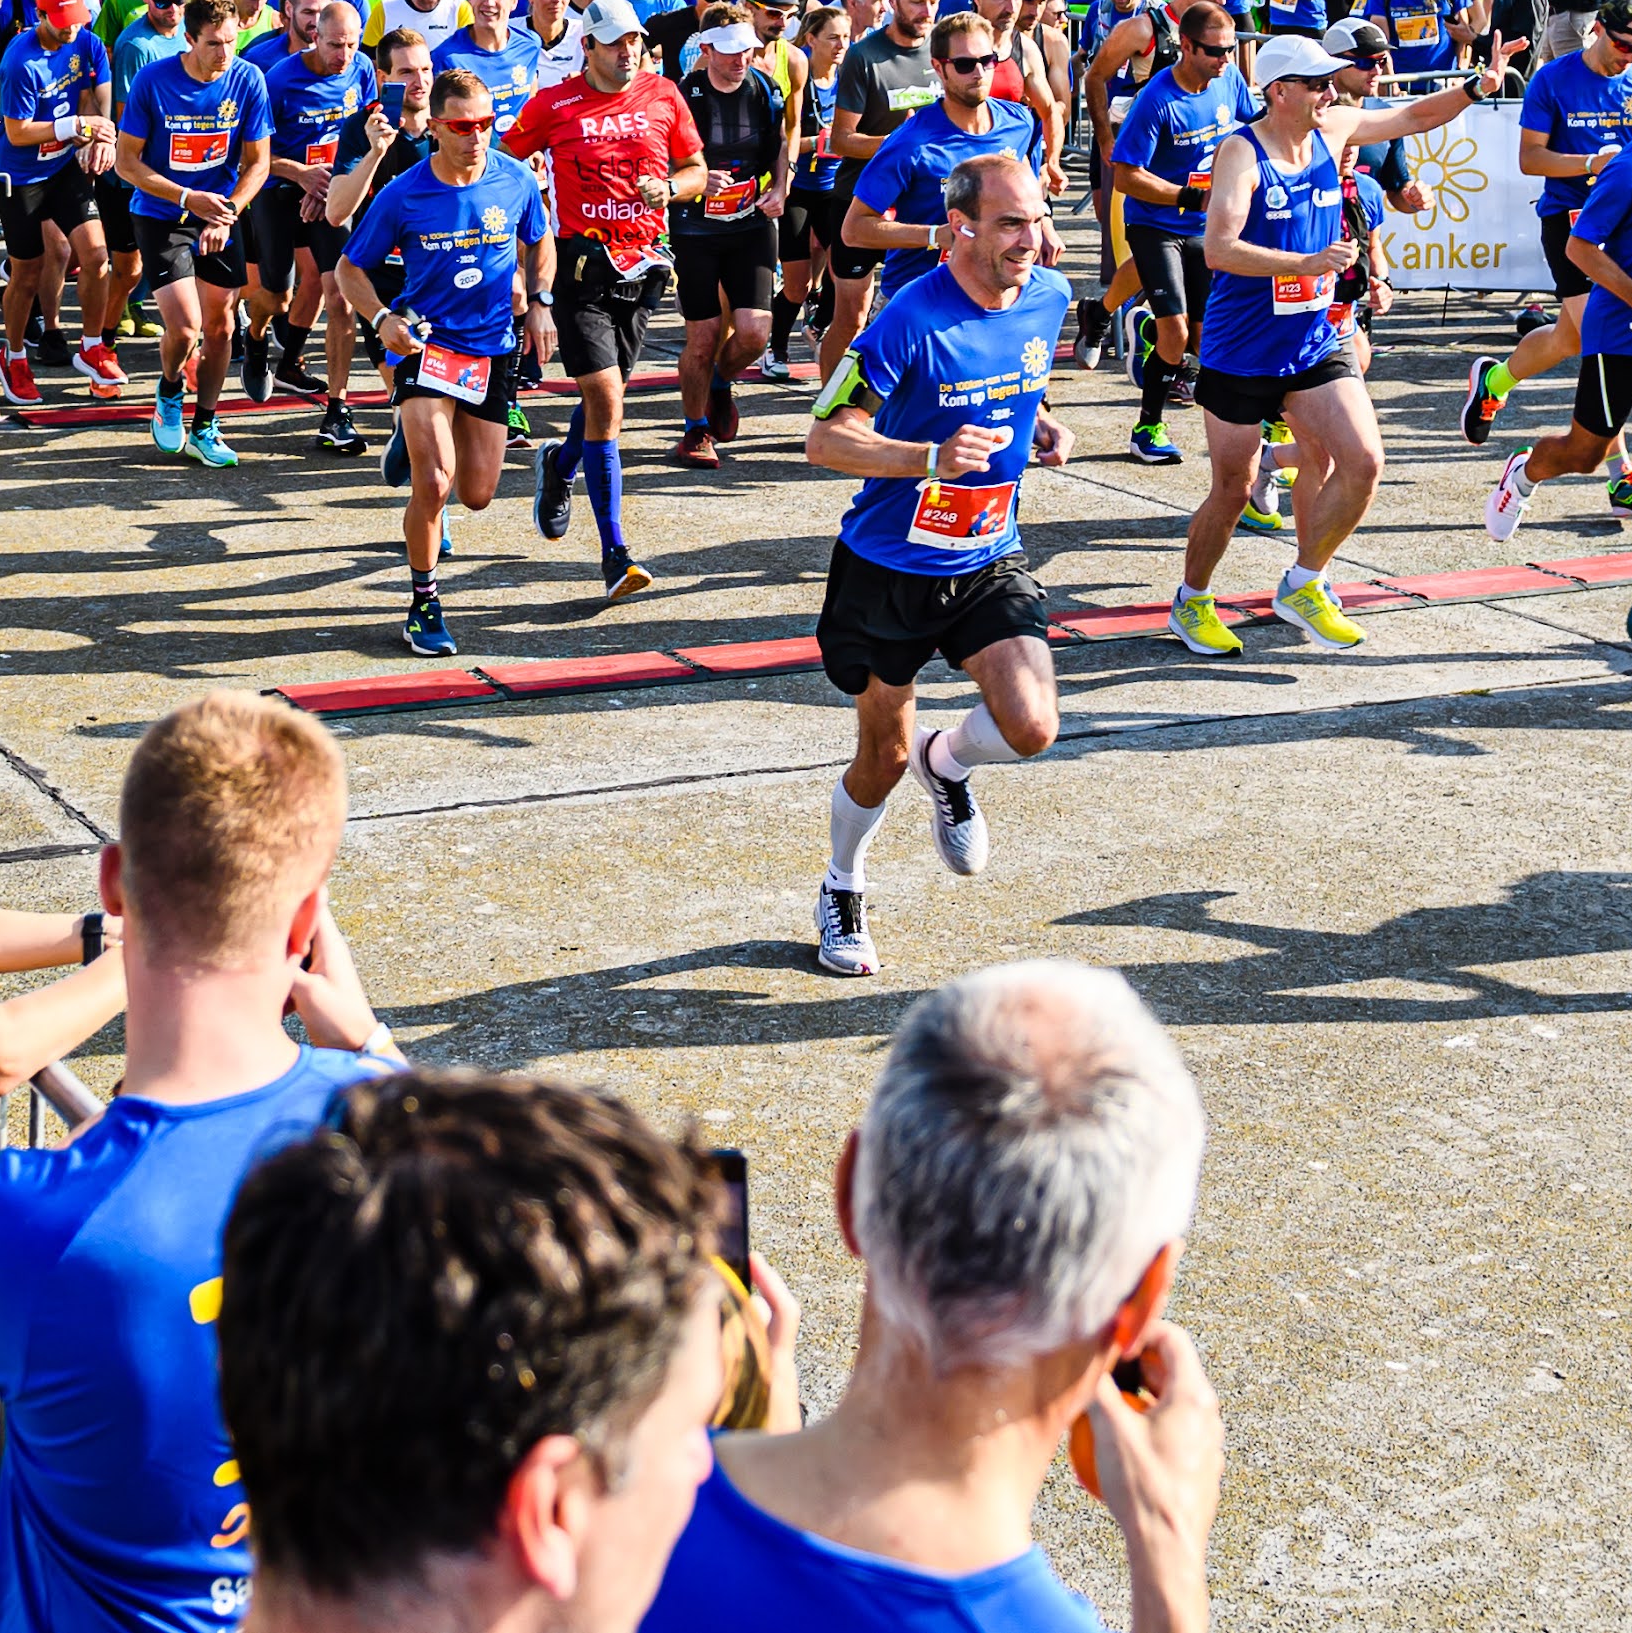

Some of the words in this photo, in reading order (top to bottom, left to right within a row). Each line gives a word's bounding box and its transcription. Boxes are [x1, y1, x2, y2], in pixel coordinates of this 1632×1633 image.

[551, 94, 584, 110] uhlsport
[580, 110, 651, 138] RAES
[1567, 118, 1585, 128] Kom
[1587, 118, 1597, 128] op
[1599, 117, 1621, 128] tegen
[584, 131, 652, 144] AUTOGROEP
[422, 241, 440, 251] Kom
[441, 240, 453, 252] op
[454, 236, 480, 249] tegen
[1382, 232, 1508, 270] Kanker
[460, 274, 478, 285] 2021
[1278, 283, 1302, 294] #123
[939, 383, 953, 393] De
[939, 392, 968, 407] Kom
[970, 390, 986, 406] op
[987, 383, 1020, 400] tegen
[922, 508, 958, 524] #248
